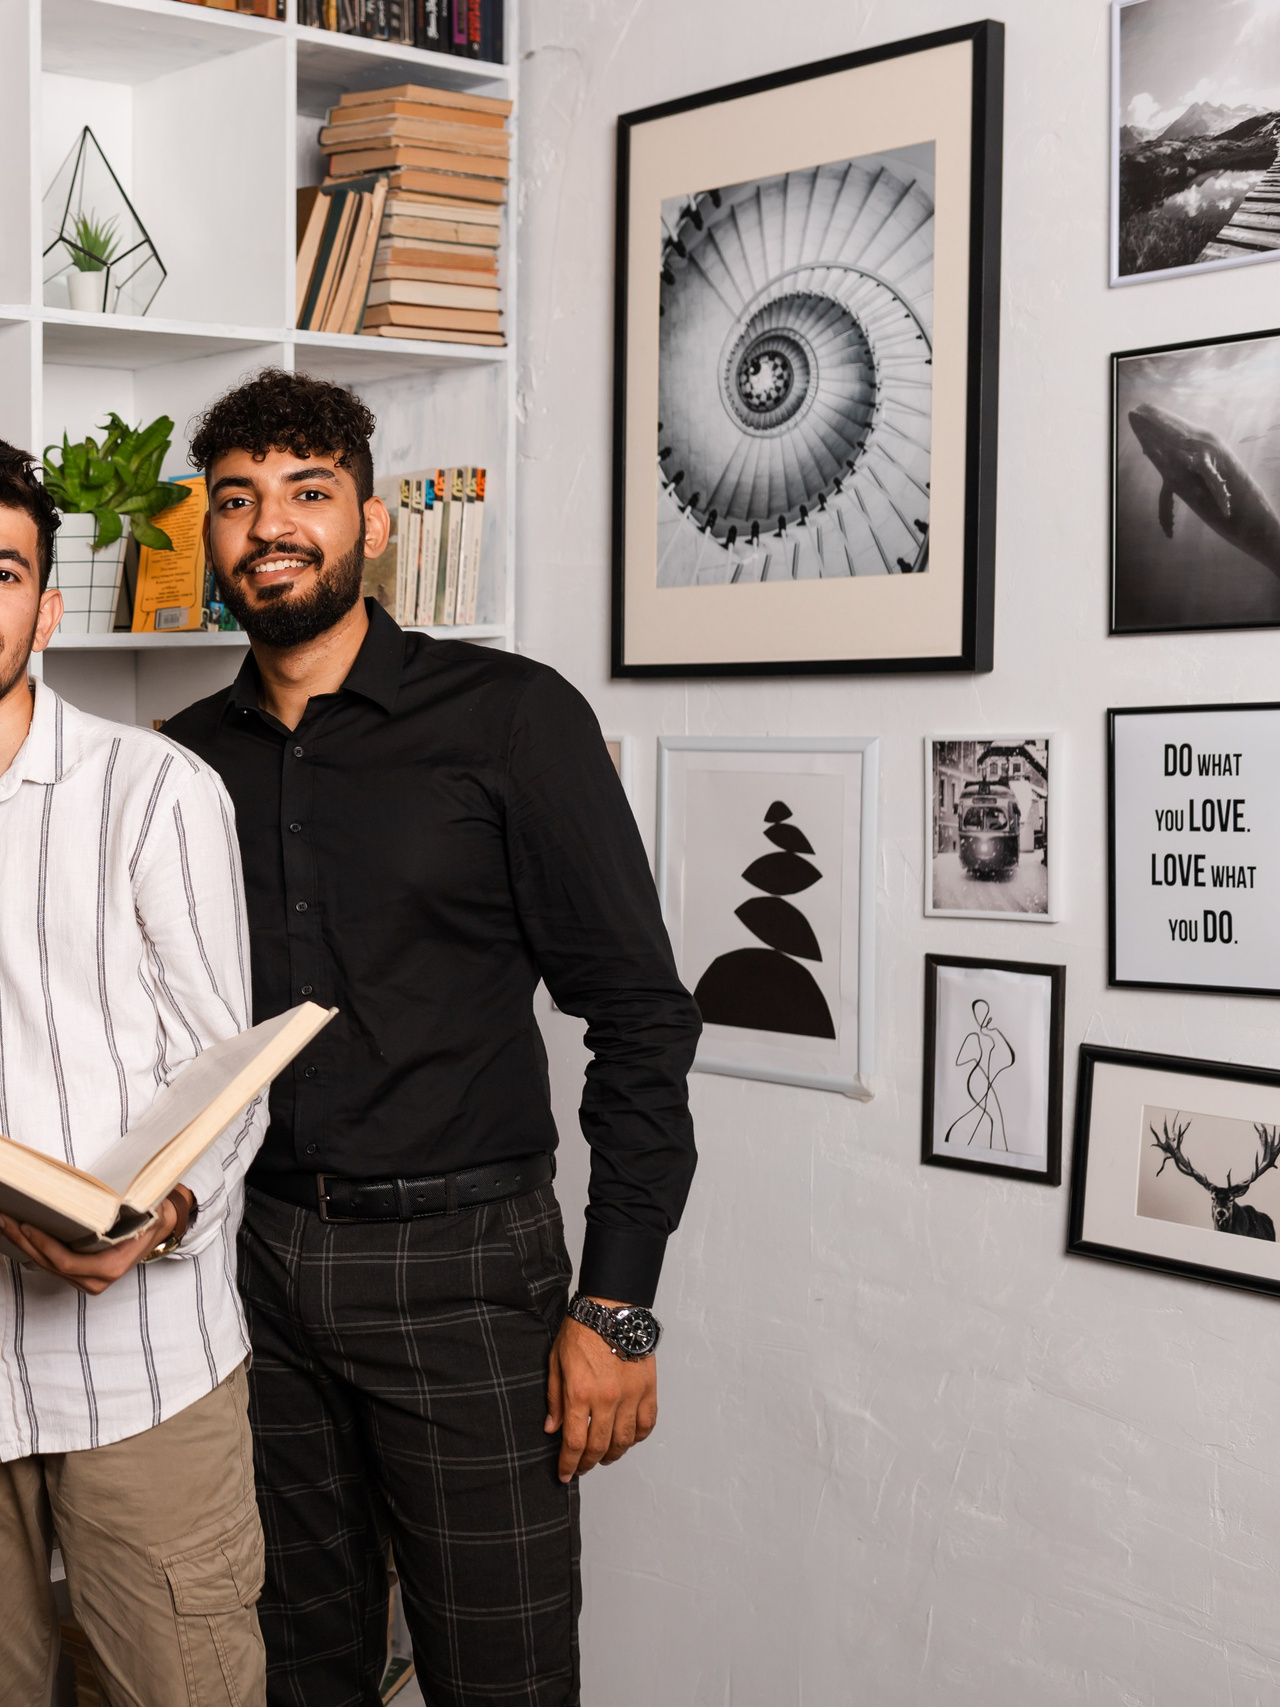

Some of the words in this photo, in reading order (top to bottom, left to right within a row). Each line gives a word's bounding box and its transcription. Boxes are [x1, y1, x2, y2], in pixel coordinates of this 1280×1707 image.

[1164, 743, 1192, 777] DO
[1197, 753, 1242, 776] WHAT
[1155, 809, 1184, 832] YOU
[1189, 799, 1251, 833] LOVE.
[1151, 853, 1206, 887] LOVE
[1211, 865, 1257, 888] WHAT
[1168, 918, 1198, 942] YOU
[1202, 909, 1238, 944] DO.
